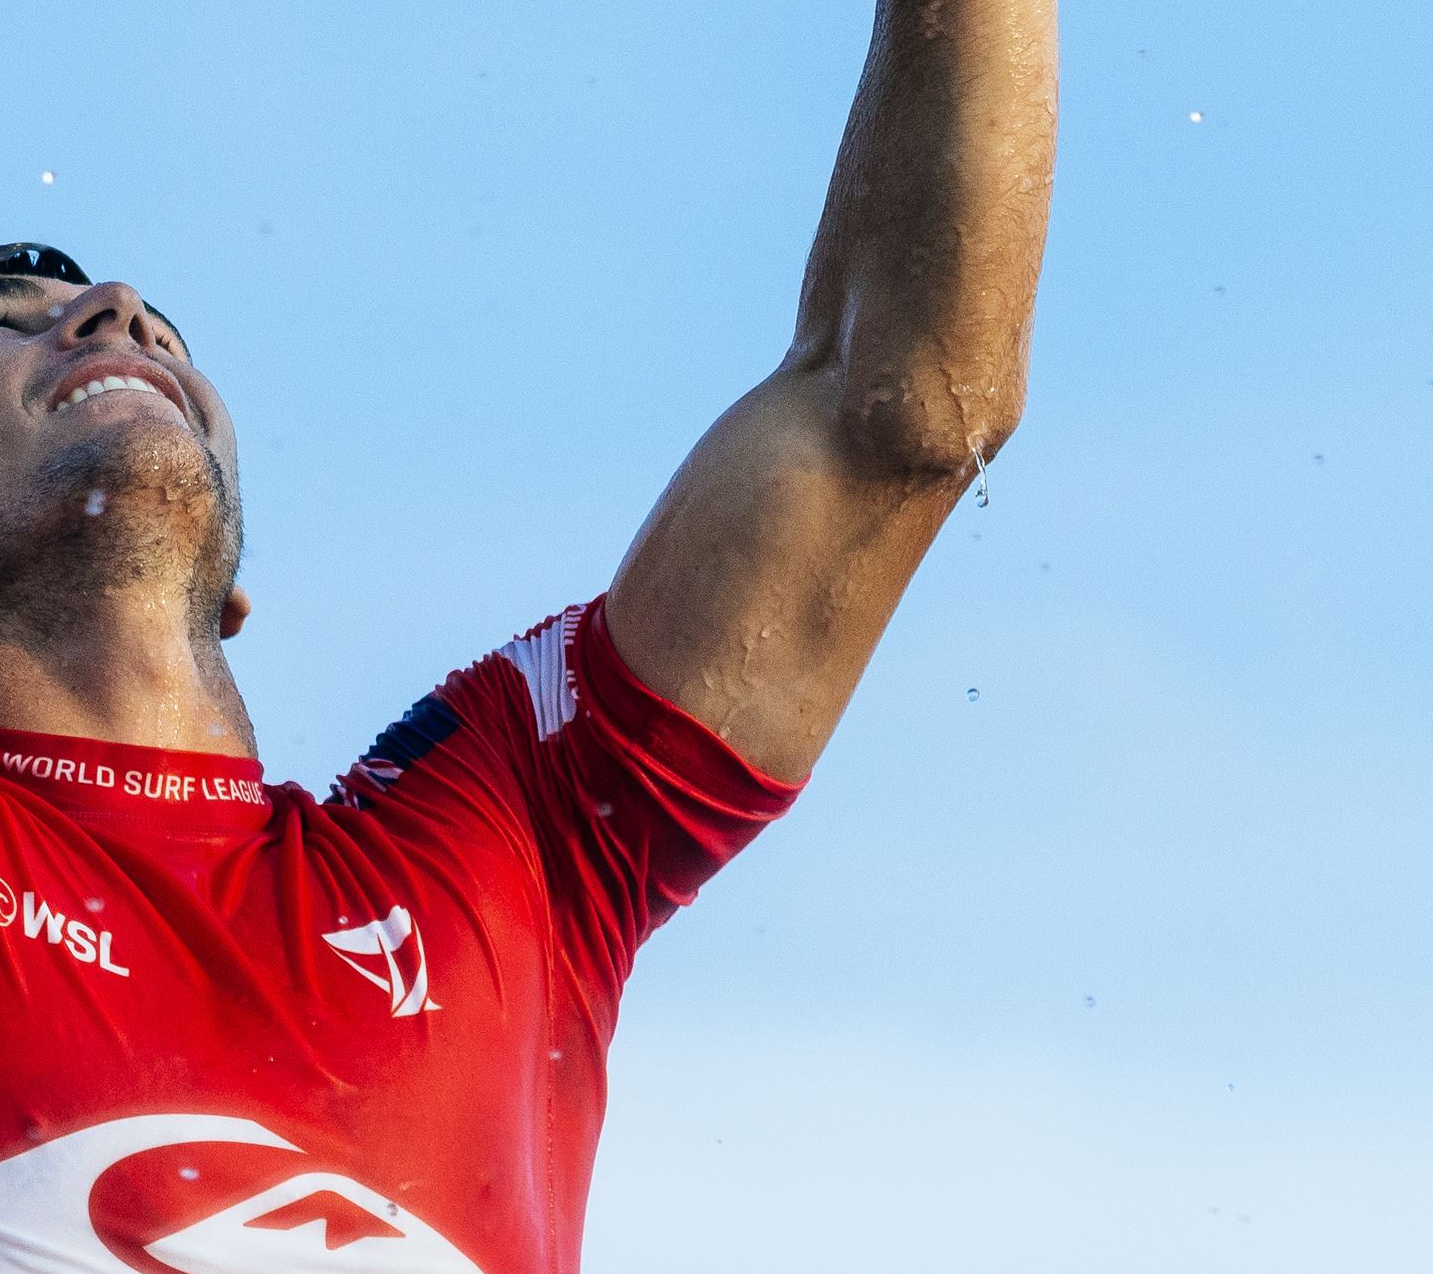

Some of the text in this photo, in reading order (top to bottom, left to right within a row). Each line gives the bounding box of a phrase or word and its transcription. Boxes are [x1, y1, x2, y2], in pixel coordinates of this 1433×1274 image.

[3, 751, 265, 806] WORLD SURF LEAGUE
[21, 890, 130, 977] WSL
